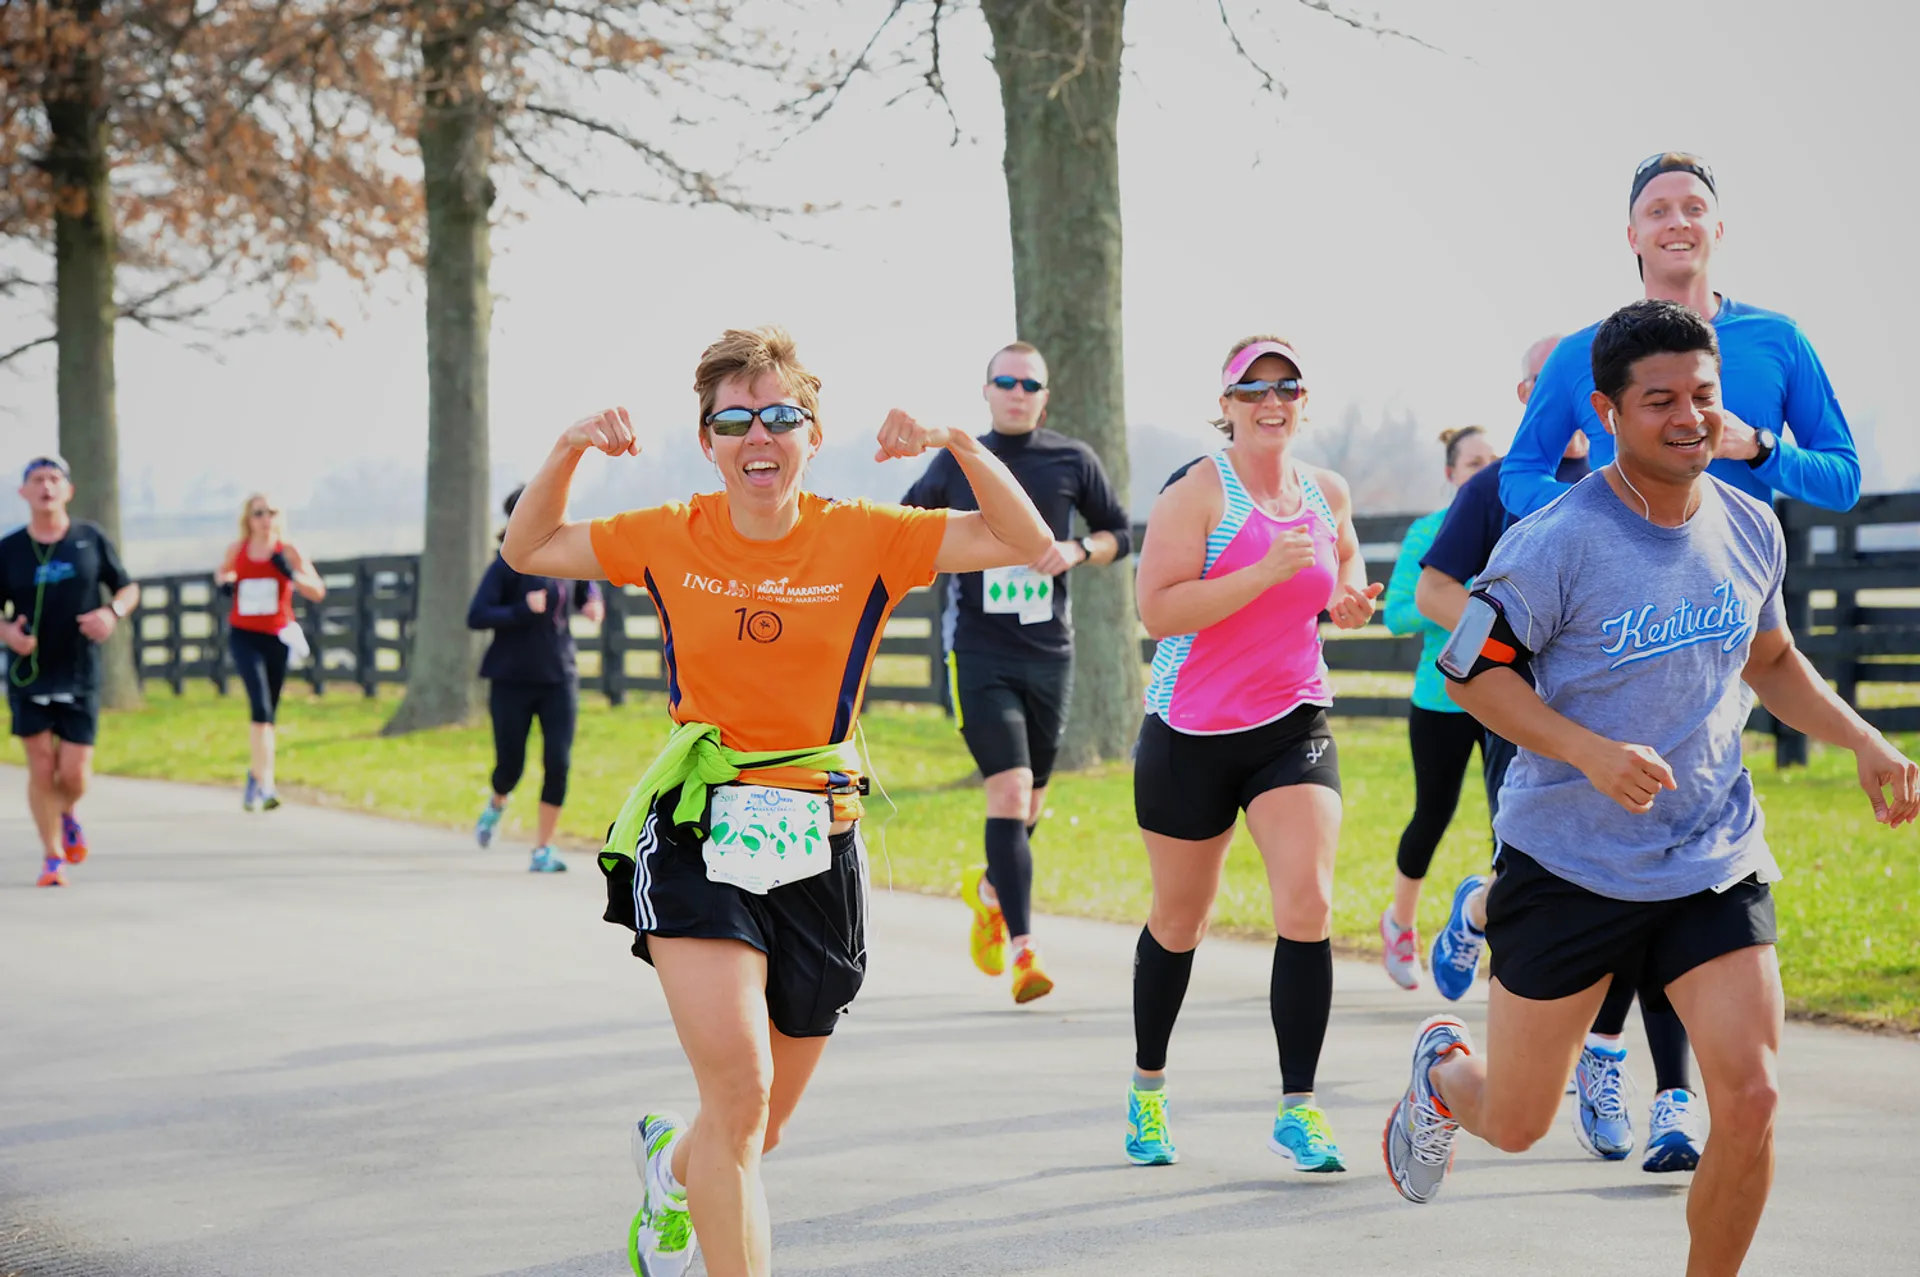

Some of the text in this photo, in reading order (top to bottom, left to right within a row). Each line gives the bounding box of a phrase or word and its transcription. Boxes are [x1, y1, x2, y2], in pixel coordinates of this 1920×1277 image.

[682, 572, 723, 594] ING
[757, 580, 785, 595] MIAMI
[757, 594, 840, 604] AND HALF MARATHON
[734, 607, 783, 643] 10
[1600, 578, 1753, 658] Kentucky
